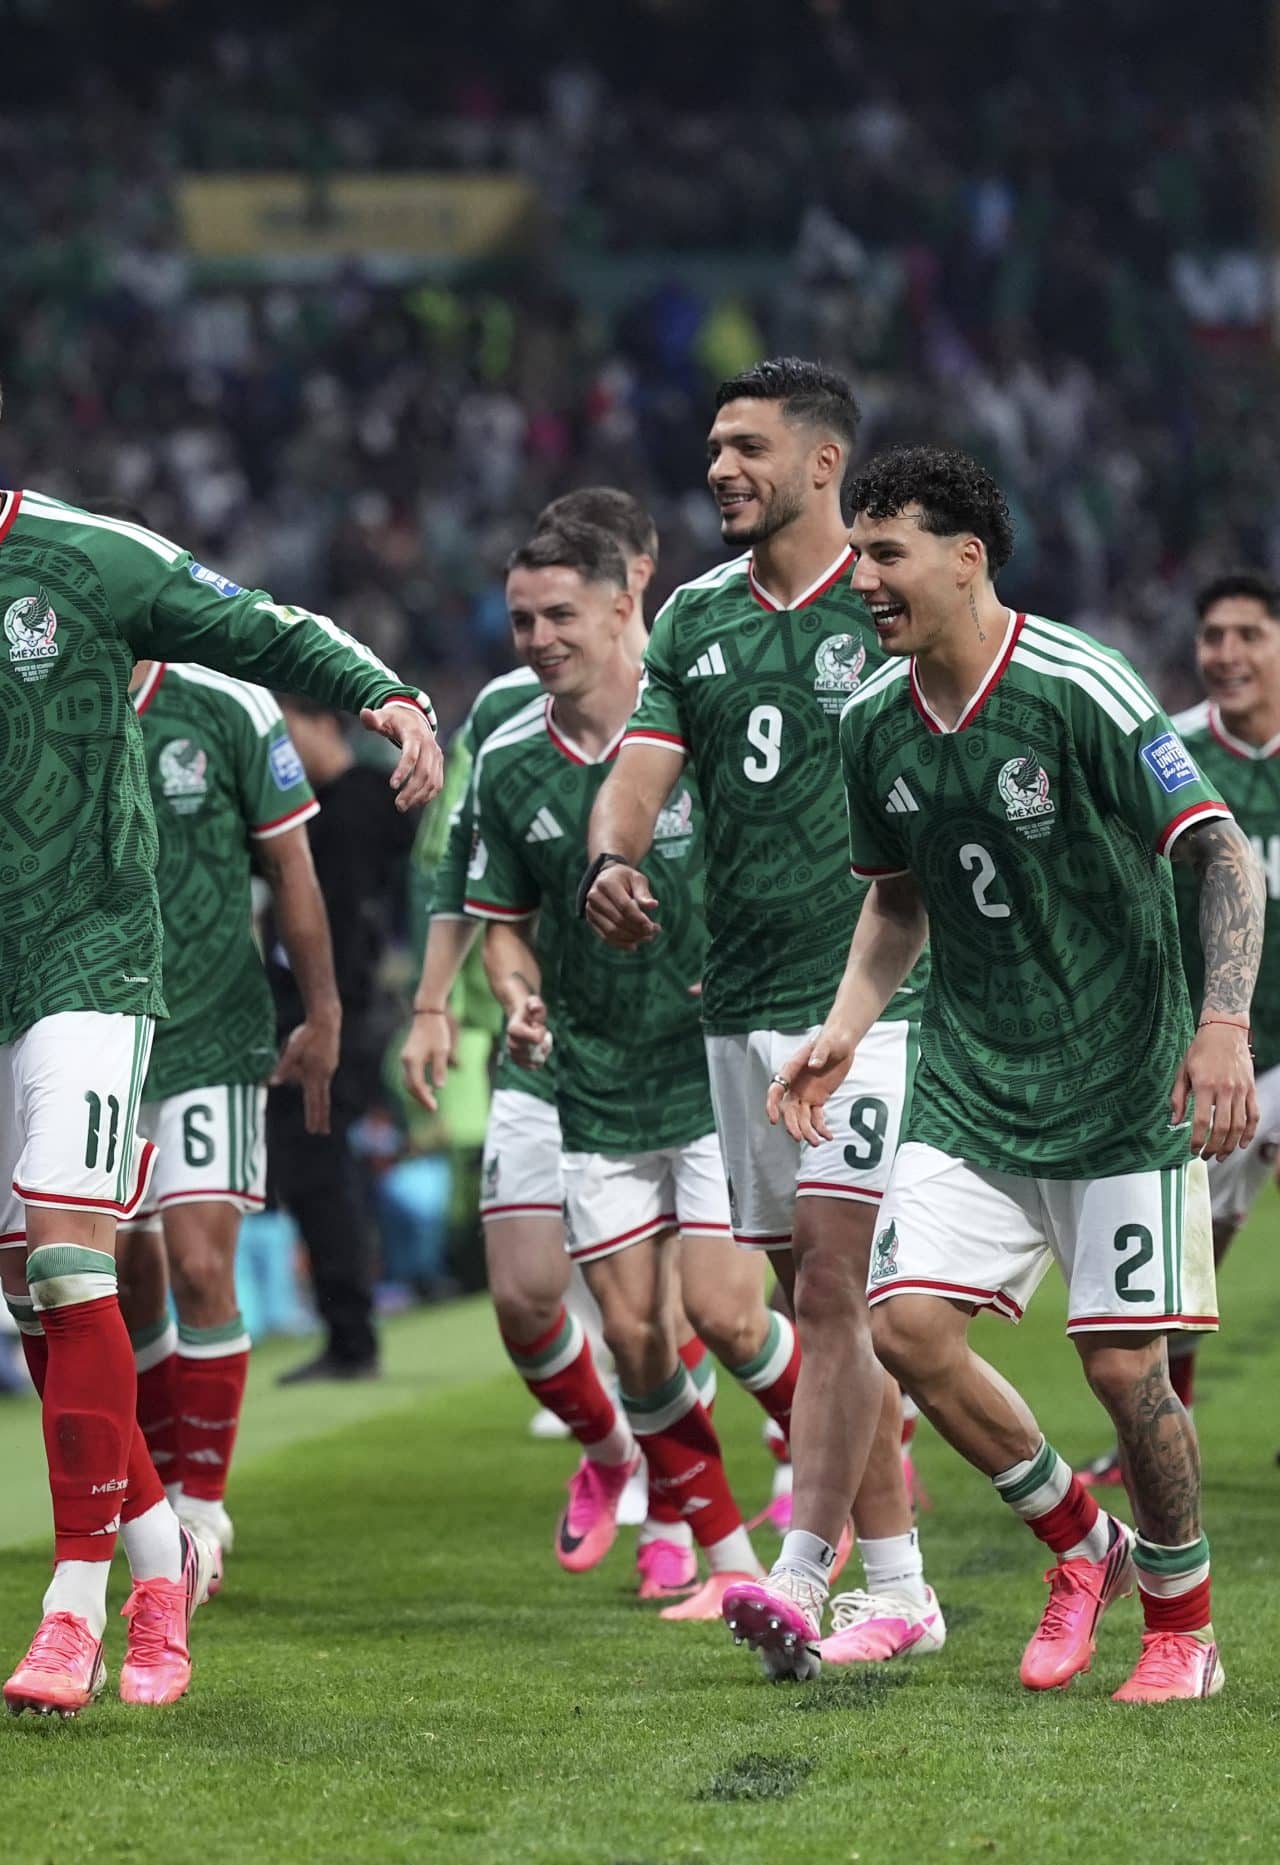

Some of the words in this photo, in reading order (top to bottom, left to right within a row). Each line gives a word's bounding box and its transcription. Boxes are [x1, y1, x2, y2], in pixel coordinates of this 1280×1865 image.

[743, 704, 783, 783] 9
[959, 843, 1011, 918] 2
[84, 1090, 120, 1174] 11
[182, 1104, 213, 1167] 6
[843, 1097, 887, 1170] 9
[1113, 1223, 1155, 1303] 2
